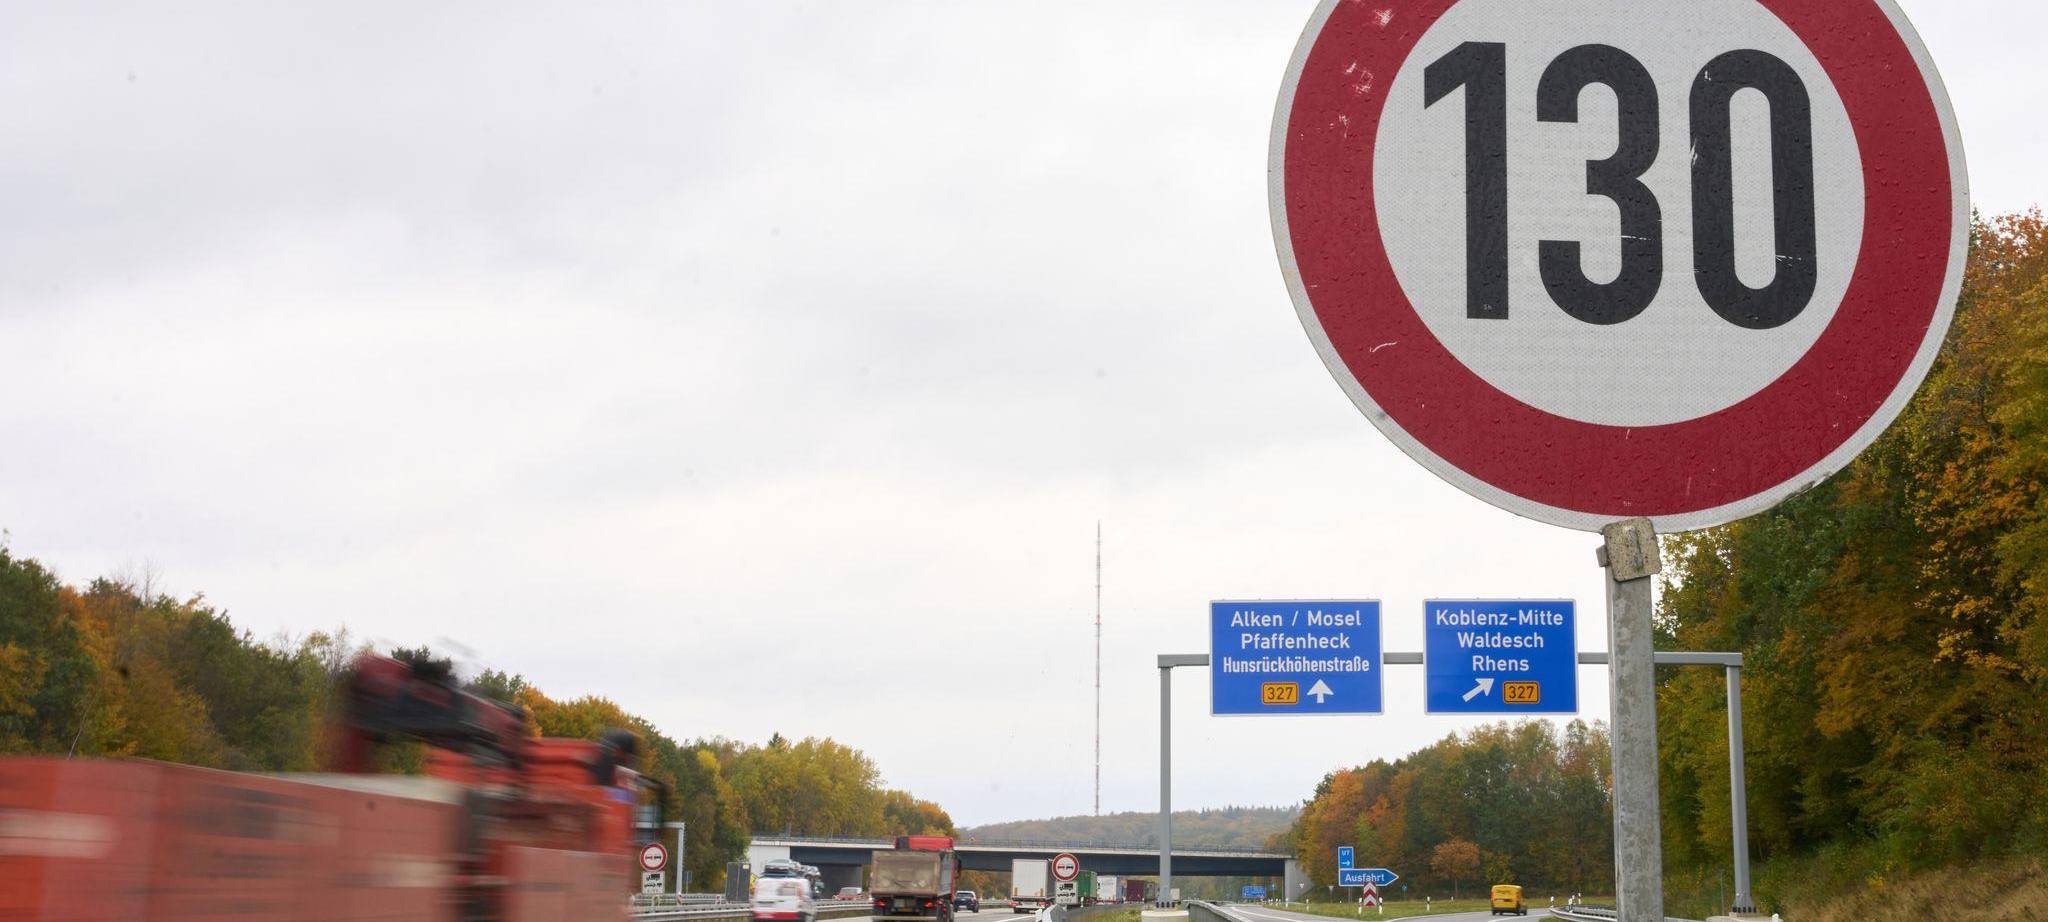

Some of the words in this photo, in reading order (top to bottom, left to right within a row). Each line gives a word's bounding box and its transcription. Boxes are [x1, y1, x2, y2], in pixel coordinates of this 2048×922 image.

[1423, 41, 1818, 330] 130
[1231, 610, 1283, 627] Alken
[1292, 610, 1299, 627] /
[1307, 610, 1361, 627] Mosel
[1436, 609, 1563, 626] Koblenz-Mitte
[1241, 633, 1350, 649] Pfaffenheck
[1457, 631, 1544, 648] Waldesch
[1223, 655, 1370, 673] Hunsrückhöhenstraße
[1472, 655, 1530, 672] Rhens
[1267, 686, 1294, 701] 327
[1508, 685, 1535, 700] 327
[1344, 873, 1385, 882] Ausfahrt
